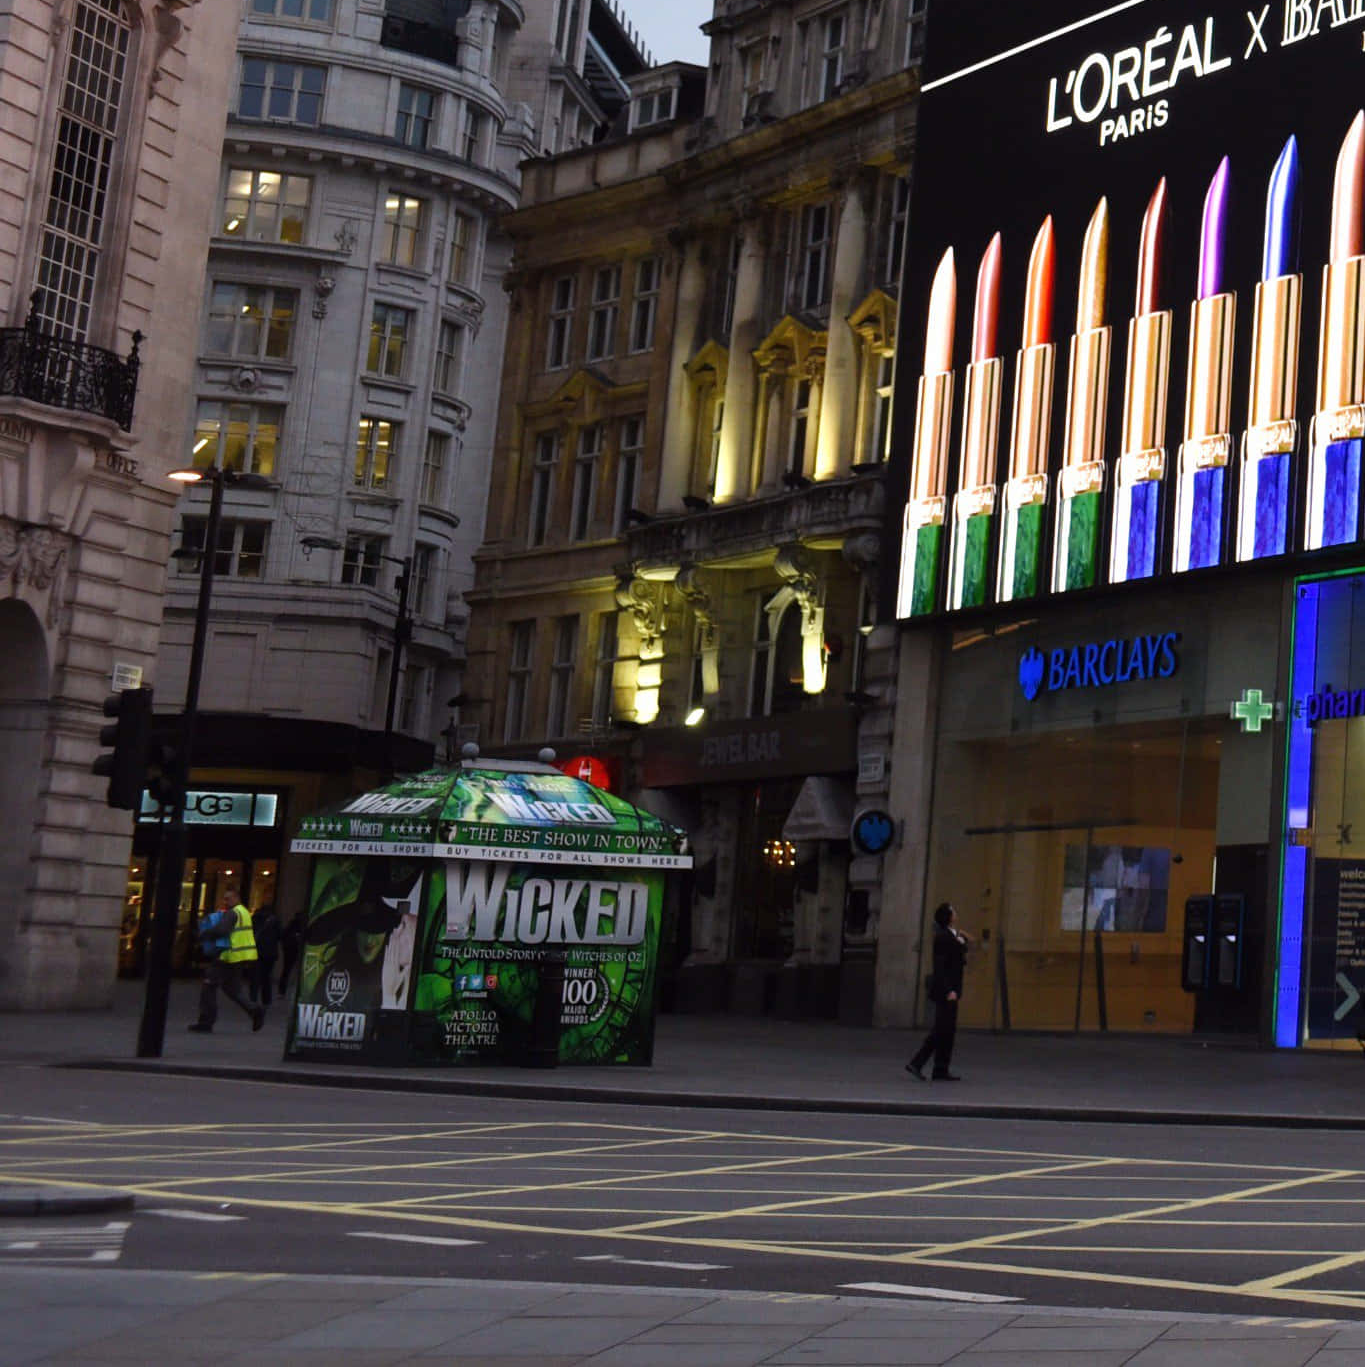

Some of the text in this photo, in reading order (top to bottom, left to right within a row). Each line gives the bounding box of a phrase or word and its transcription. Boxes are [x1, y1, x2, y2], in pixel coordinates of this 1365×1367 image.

[1045, 15, 1232, 133] L'ORÉAL
[1048, 630, 1178, 691] BARCLAYS
[484, 792, 617, 824] WICKED
[295, 841, 427, 854] TICKETS FOR ALL SHOWS
[503, 828, 539, 845] BEST
[543, 831, 590, 847] SHOW
[593, 833, 611, 848] IN
[446, 845, 680, 866] BUY TICKETS FOR ALL SHOWS HERE
[440, 862, 649, 946] WICKED
[440, 947, 463, 959] THE
[463, 947, 505, 960] UNTOLD
[506, 948, 537, 961] STORY
[572, 950, 613, 962] WITCHES
[330, 977, 346, 991] 100
[561, 978, 598, 1005] 100
[298, 1003, 366, 1042] WICKED
[451, 1009, 497, 1021] APOLLO
[444, 1022, 500, 1034] VICTORIA
[444, 1034, 497, 1045] THEATRE
